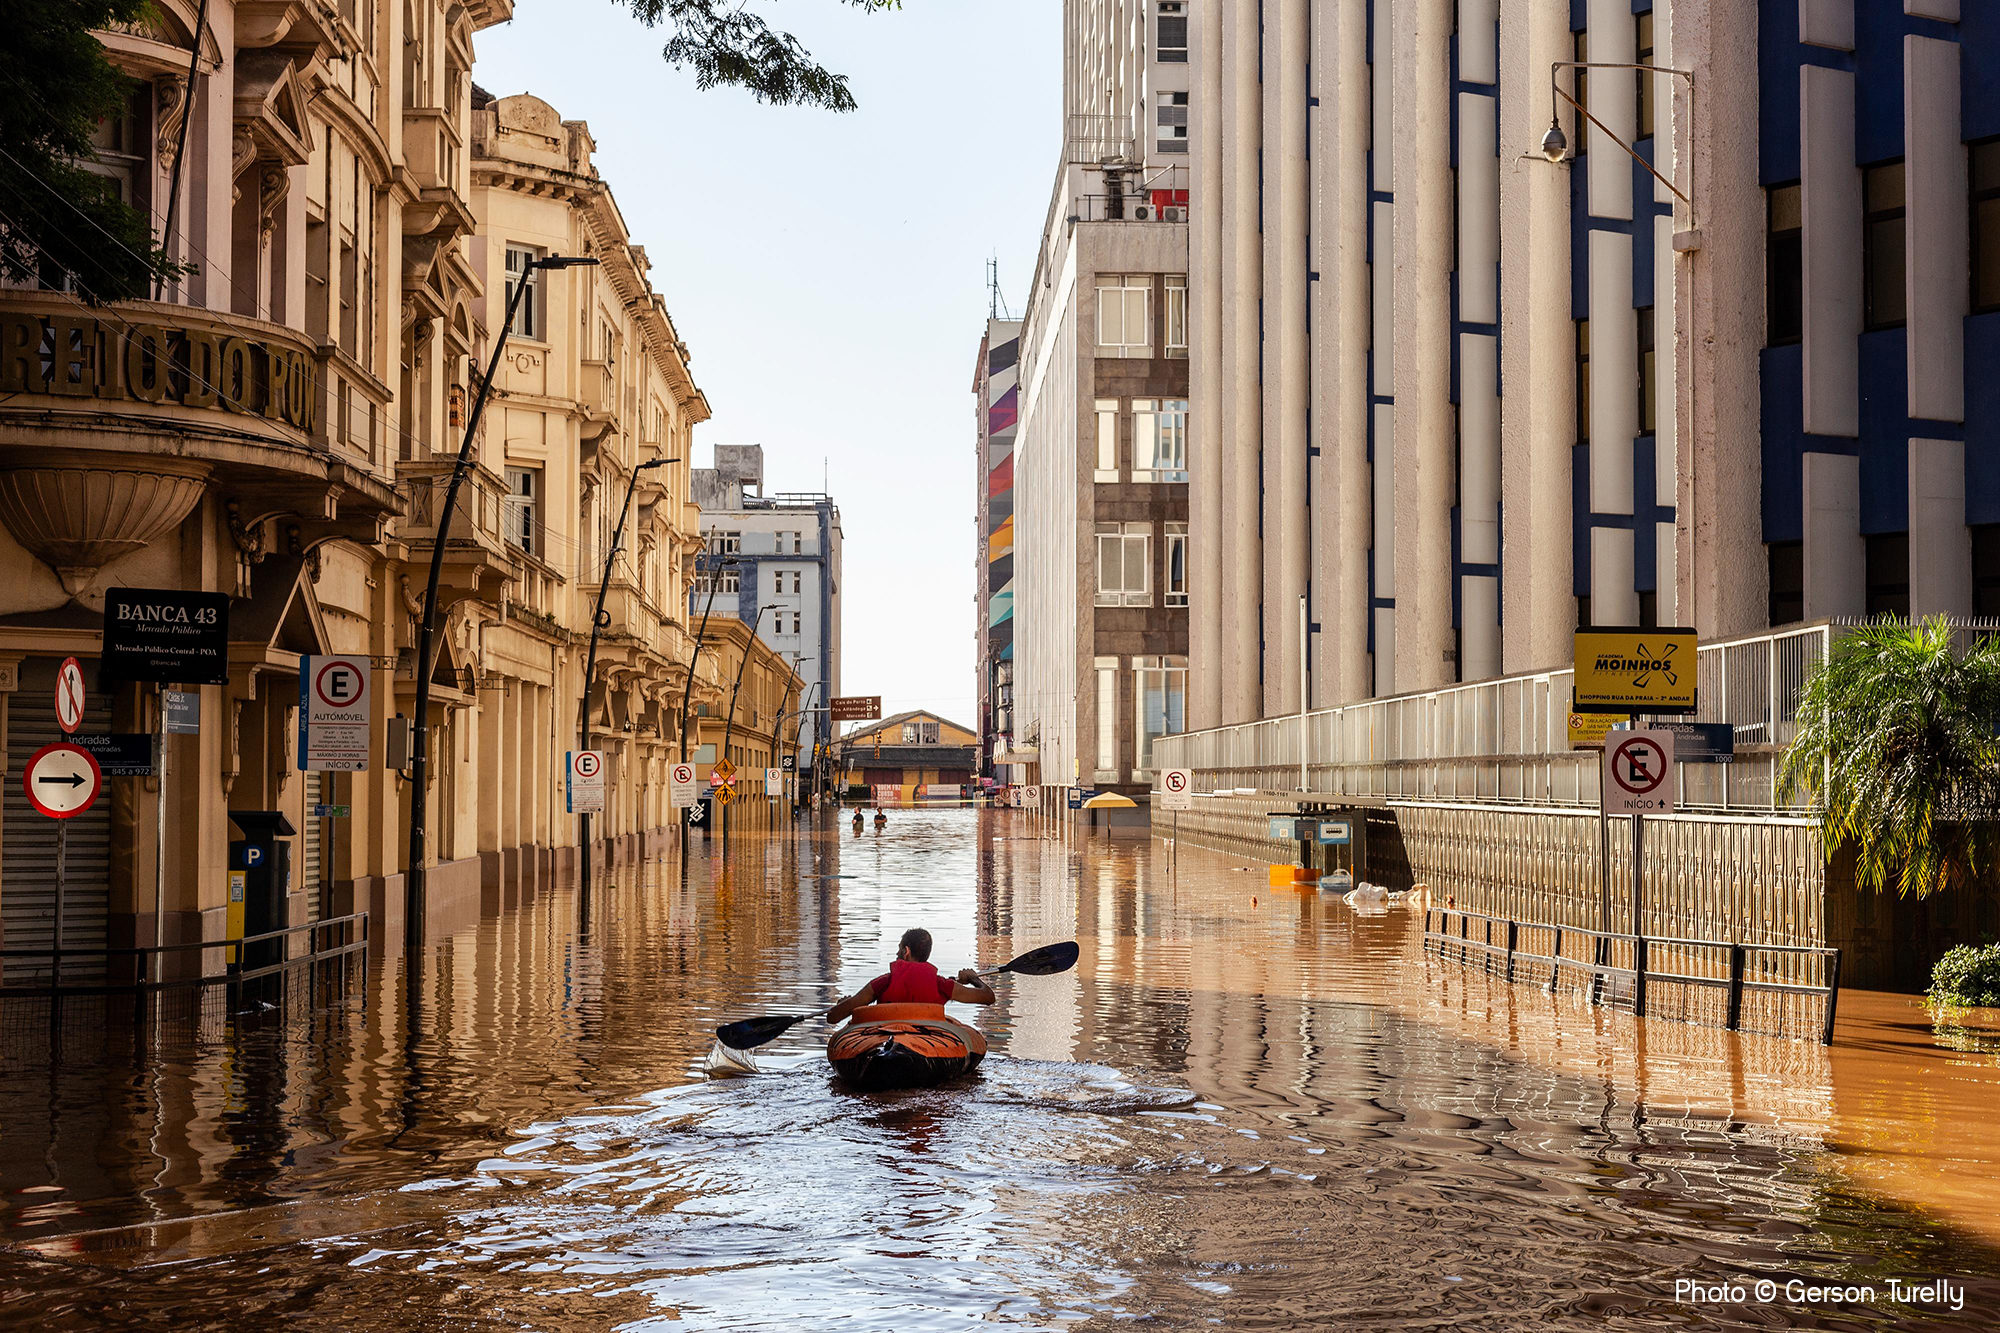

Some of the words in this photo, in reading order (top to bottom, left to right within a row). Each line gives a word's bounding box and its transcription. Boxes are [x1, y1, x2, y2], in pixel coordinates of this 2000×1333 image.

[184, 329, 251, 413] DO
[117, 603, 190, 623] BANCA
[194, 607, 217, 624] 43
[136, 624, 170, 633] Mercado
[171, 625, 201, 635] Público
[115, 644, 143, 652] Mercado
[144, 645, 169, 654] Público
[170, 646, 195, 655] Central
[200, 648, 217, 656] POA
[1594, 659, 1671, 671] MOINHOS
[331, 671, 349, 697] E
[314, 712, 365, 721] AUTOMÓVEL
[1651, 723, 1695, 733] Andradas
[325, 760, 351, 769] INÍCIO
[583, 757, 592, 772] E
[1715, 755, 1733, 763] 1000
[1629, 750, 1648, 782] E
[1263, 790, 1289, 798] 1160-1161
[1624, 799, 1654, 809] INÍCIO
[248, 848, 261, 864] P
